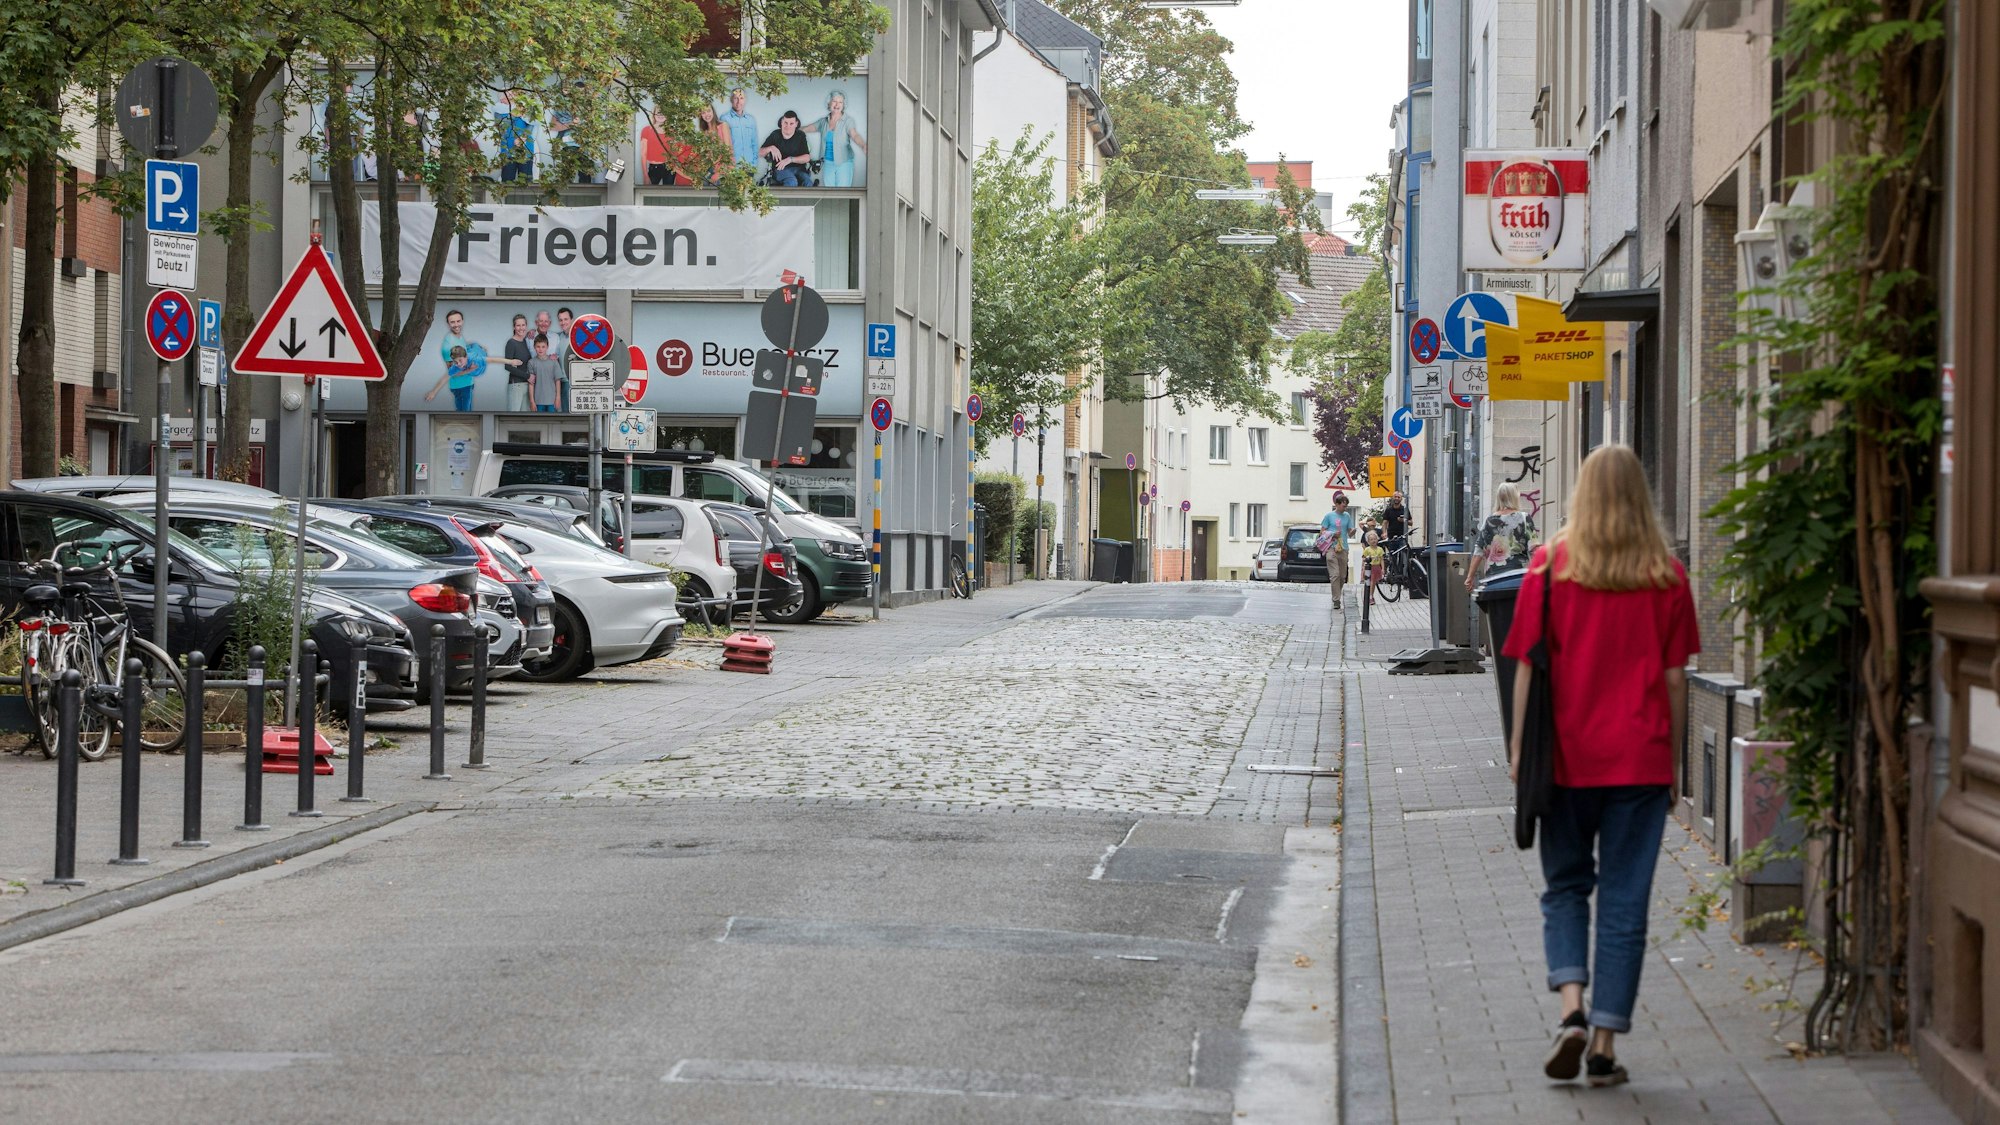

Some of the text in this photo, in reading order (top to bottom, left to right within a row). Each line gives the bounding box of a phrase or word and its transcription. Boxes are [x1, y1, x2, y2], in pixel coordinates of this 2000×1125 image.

[155, 170, 183, 223] P
[457, 212, 717, 266] Frieden.
[1510, 230, 1541, 239] KÖLSCH
[153, 237, 194, 252] Bewohner
[157, 257, 183, 272] Deutz
[1486, 277, 1534, 291] Arminiusstr.
[204, 306, 216, 342] P
[874, 328, 889, 354] P
[1535, 329, 1592, 344] DHL
[1534, 351, 1594, 362] PAKETSHOP
[872, 382, 876, 390] 9
[880, 382, 887, 391] 22
[888, 383, 891, 391] h
[1468, 383, 1483, 391] frei
[1379, 462, 1386, 471] U
